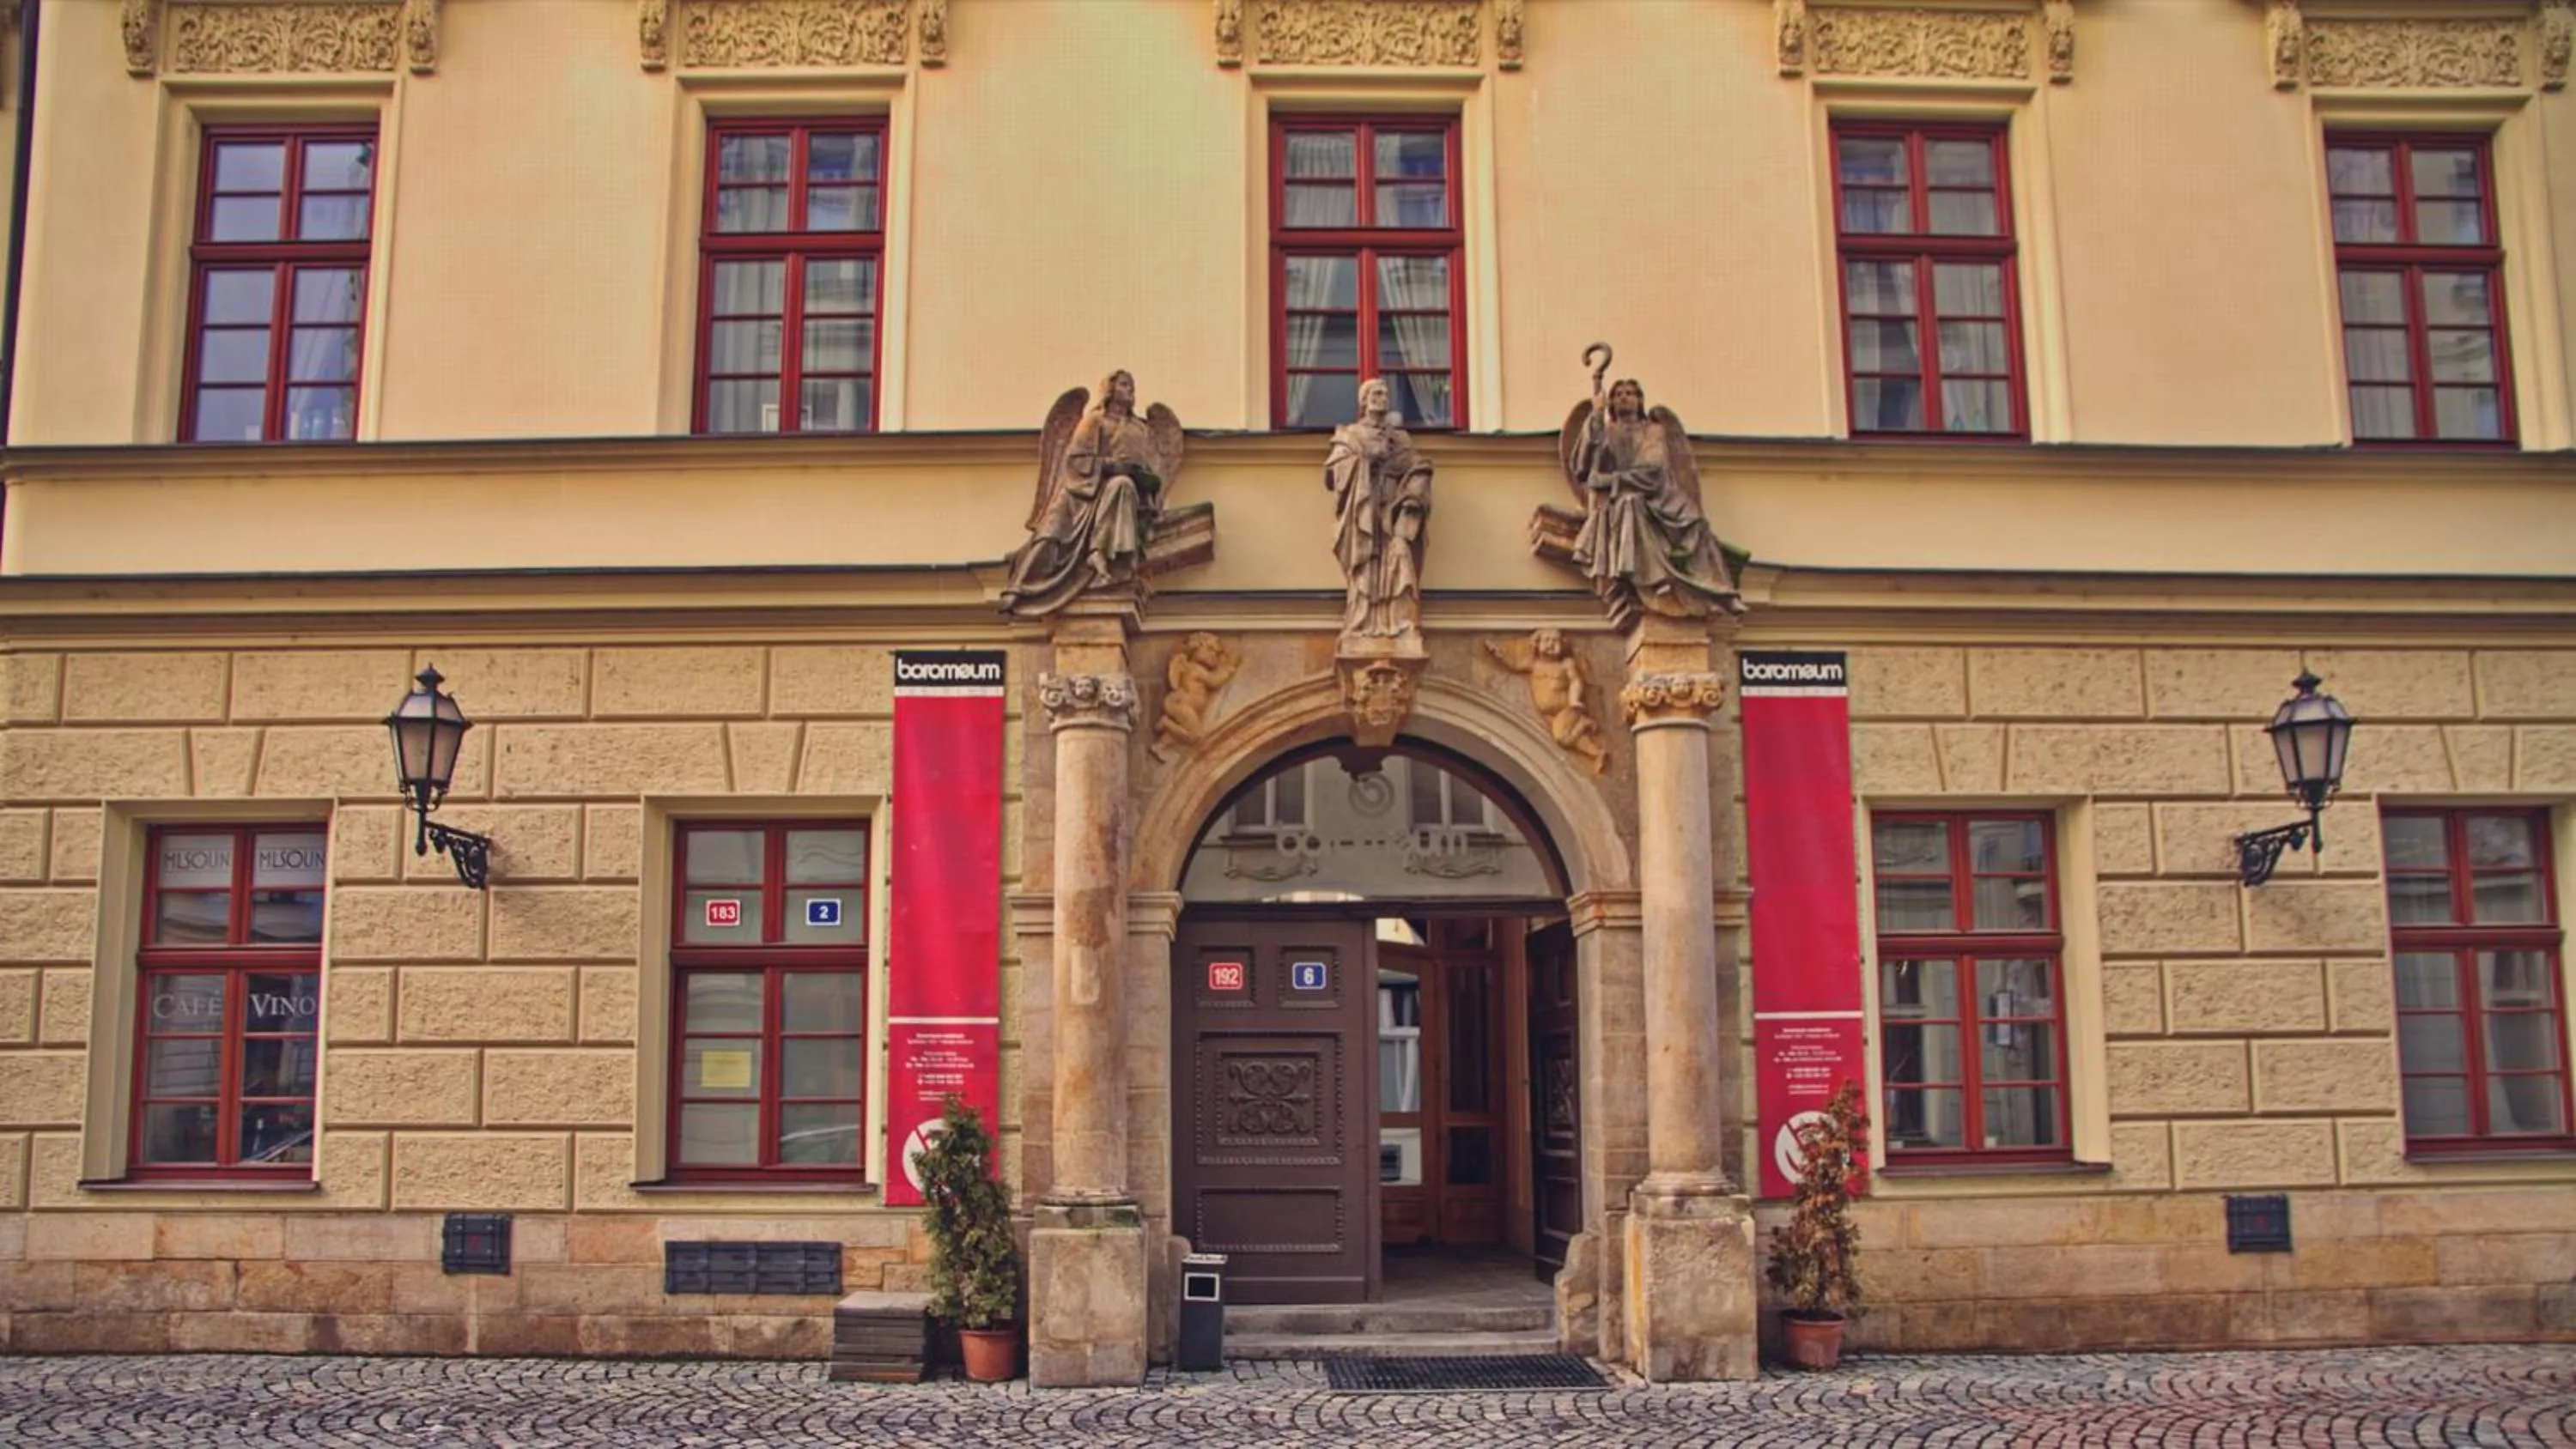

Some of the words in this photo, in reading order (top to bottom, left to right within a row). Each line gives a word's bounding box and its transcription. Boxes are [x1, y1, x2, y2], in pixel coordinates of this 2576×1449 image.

[897, 658, 1000, 679] boromeum
[1742, 658, 1843, 679] boromeum
[710, 906, 736, 920] 183
[818, 906, 829, 919] 2
[1214, 967, 1238, 985] 192
[1303, 967, 1315, 985] 6
[250, 992, 316, 1018] VINO
